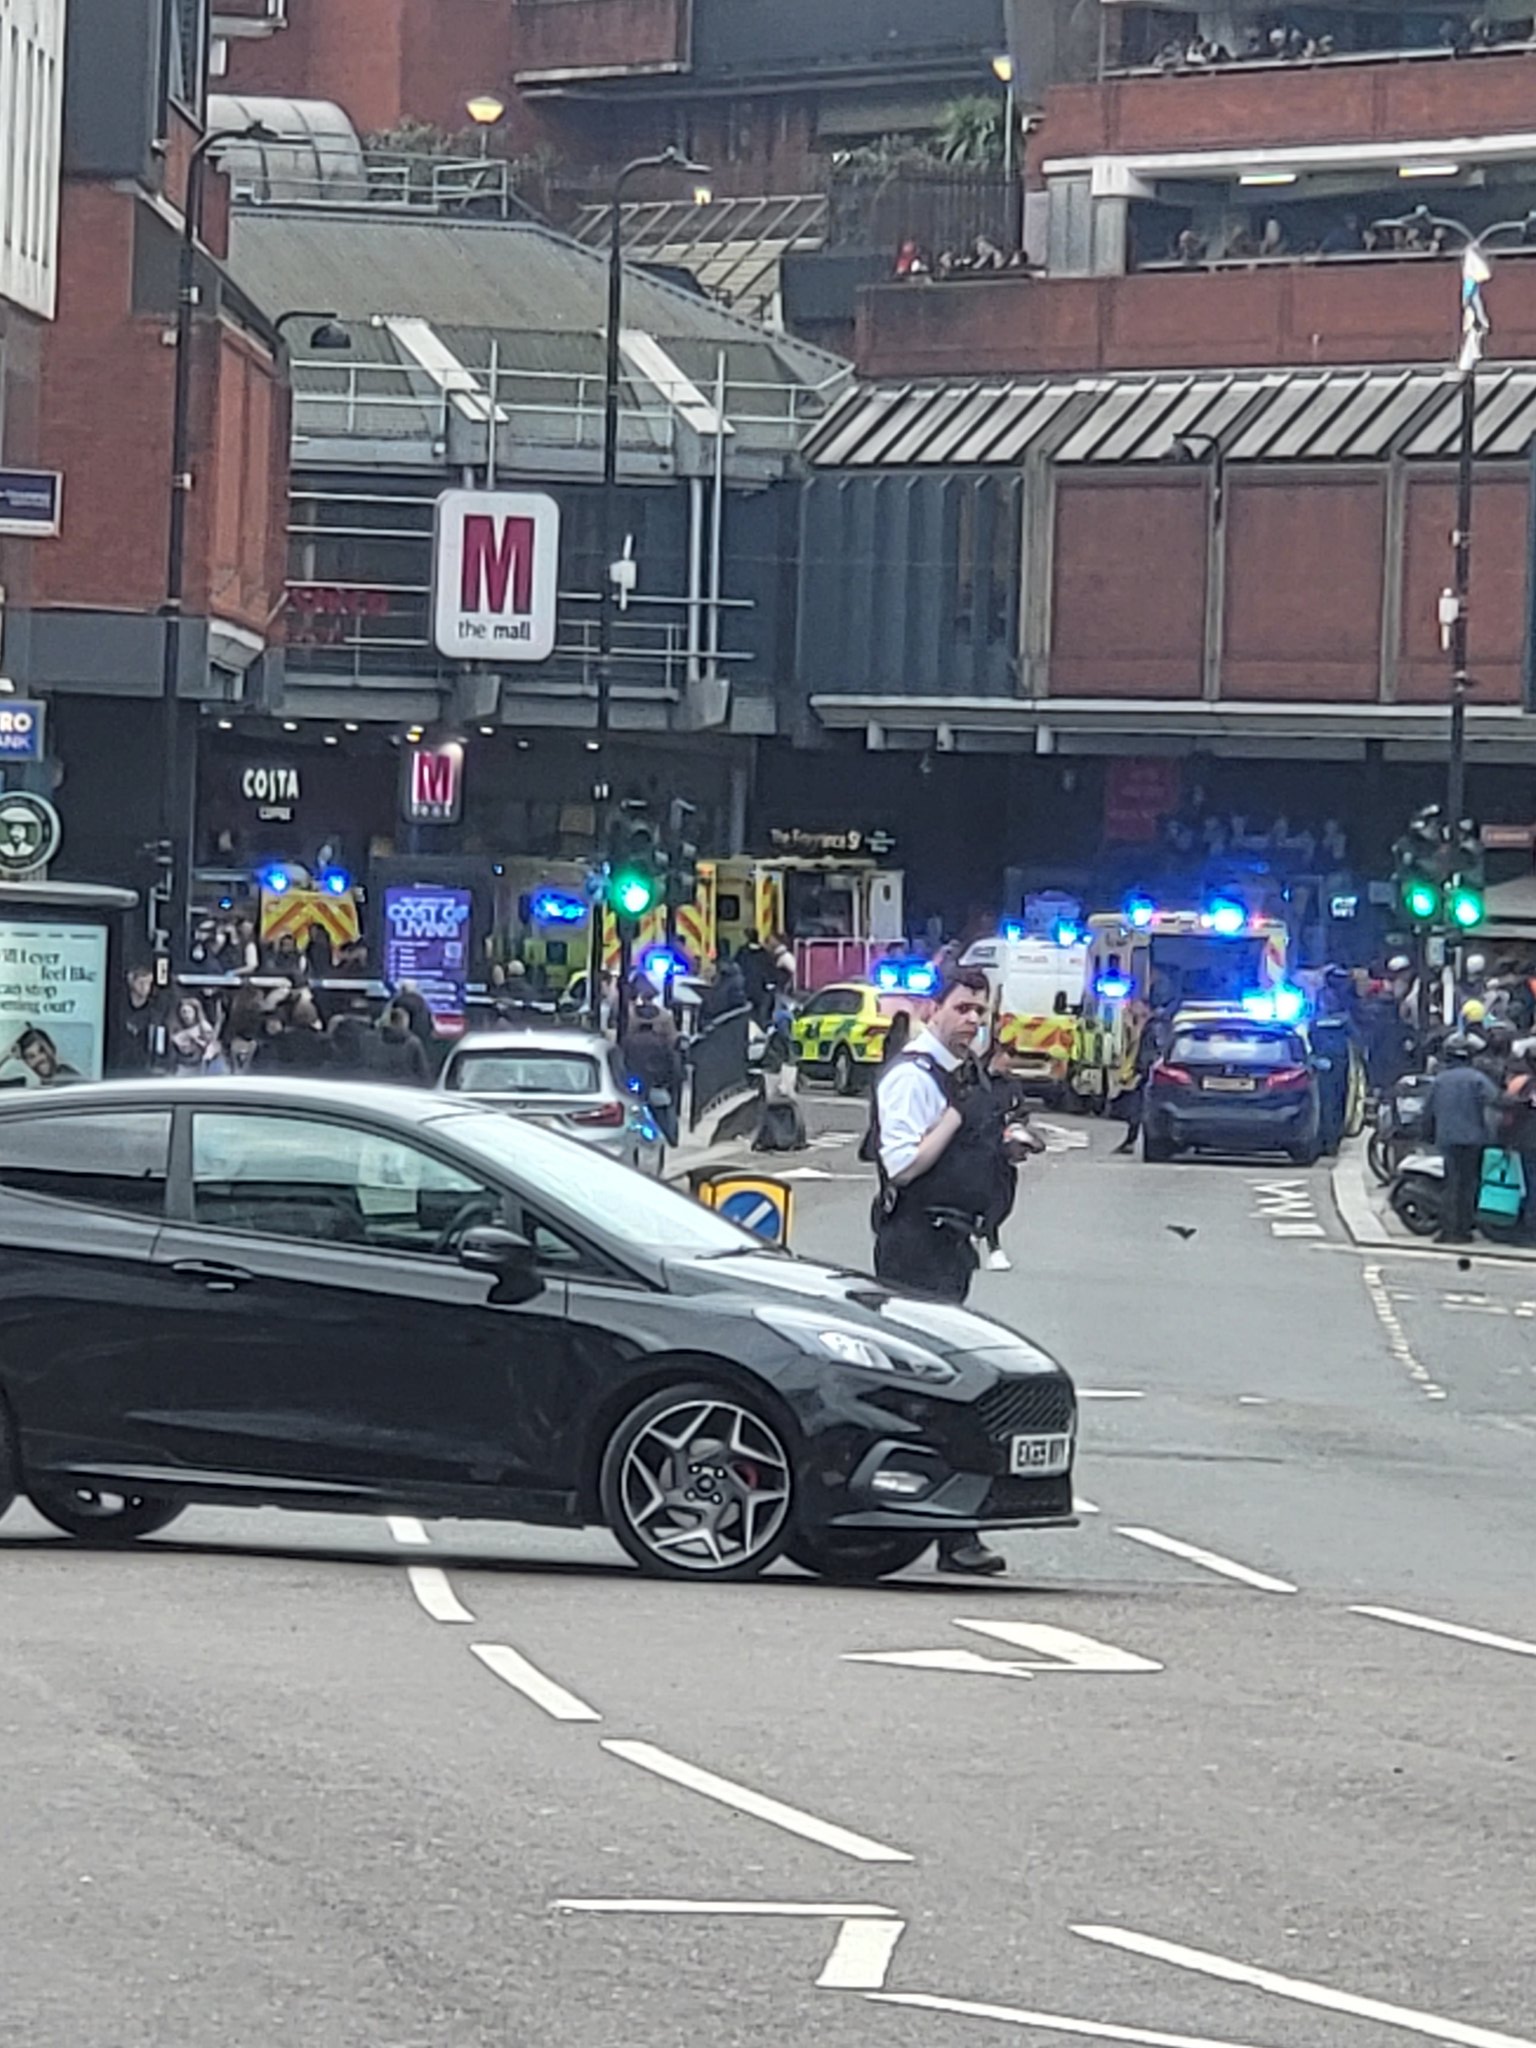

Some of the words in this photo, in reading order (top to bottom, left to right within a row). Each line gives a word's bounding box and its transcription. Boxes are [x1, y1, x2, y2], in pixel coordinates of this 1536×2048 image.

[461, 514, 534, 614] M
[459, 619, 486, 638] the
[493, 621, 531, 640] mall
[243, 769, 299, 801] COSTA
[388, 904, 437, 923] COST
[396, 920, 458, 937] LIVING
[20, 948, 27, 963] I
[28, 952, 61, 965] ever
[41, 965, 66, 981] feel
[70, 966, 97, 982] like
[25, 983, 57, 998] stop
[43, 999, 76, 1014] out?
